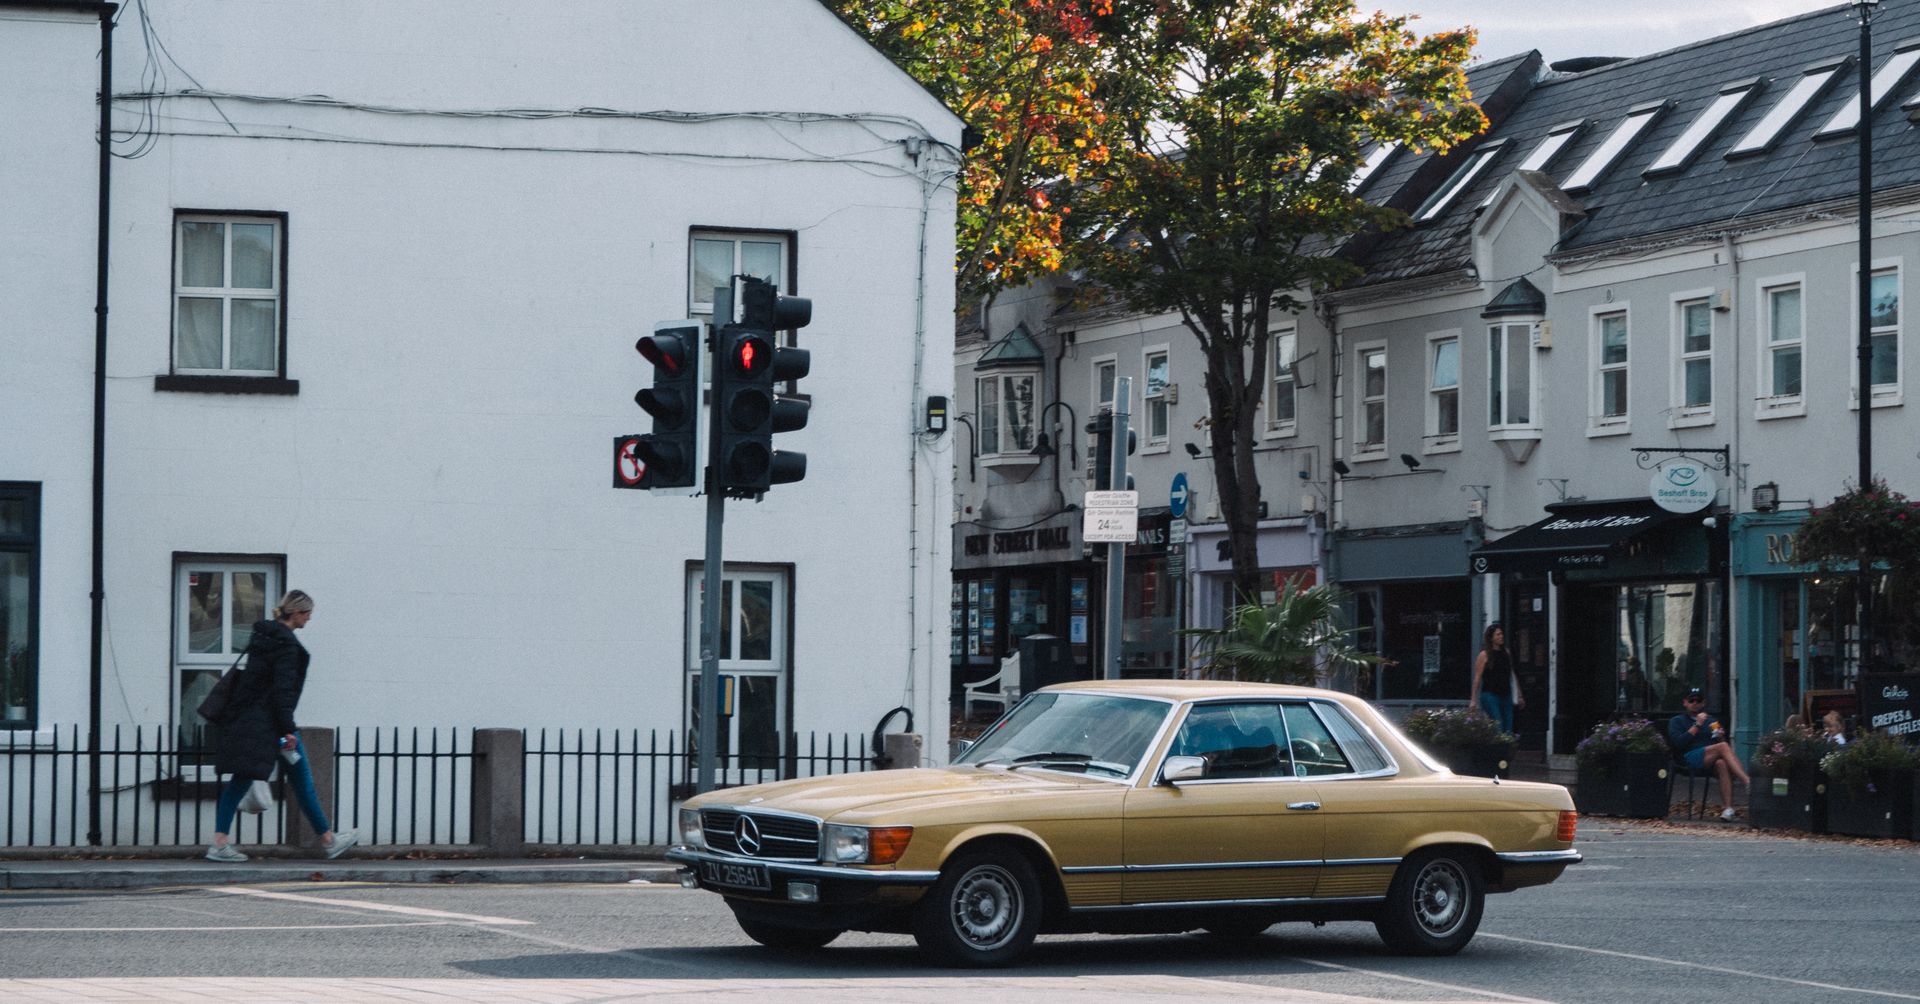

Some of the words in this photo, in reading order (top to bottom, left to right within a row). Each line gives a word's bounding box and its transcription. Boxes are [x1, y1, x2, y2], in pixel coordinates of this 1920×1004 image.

[1098, 519, 1110, 530] 24
[993, 530, 1035, 554] STREET
[1872, 710, 1905, 728] CREPES
[706, 862, 720, 881] ZV
[722, 865, 760, 887] 25641
